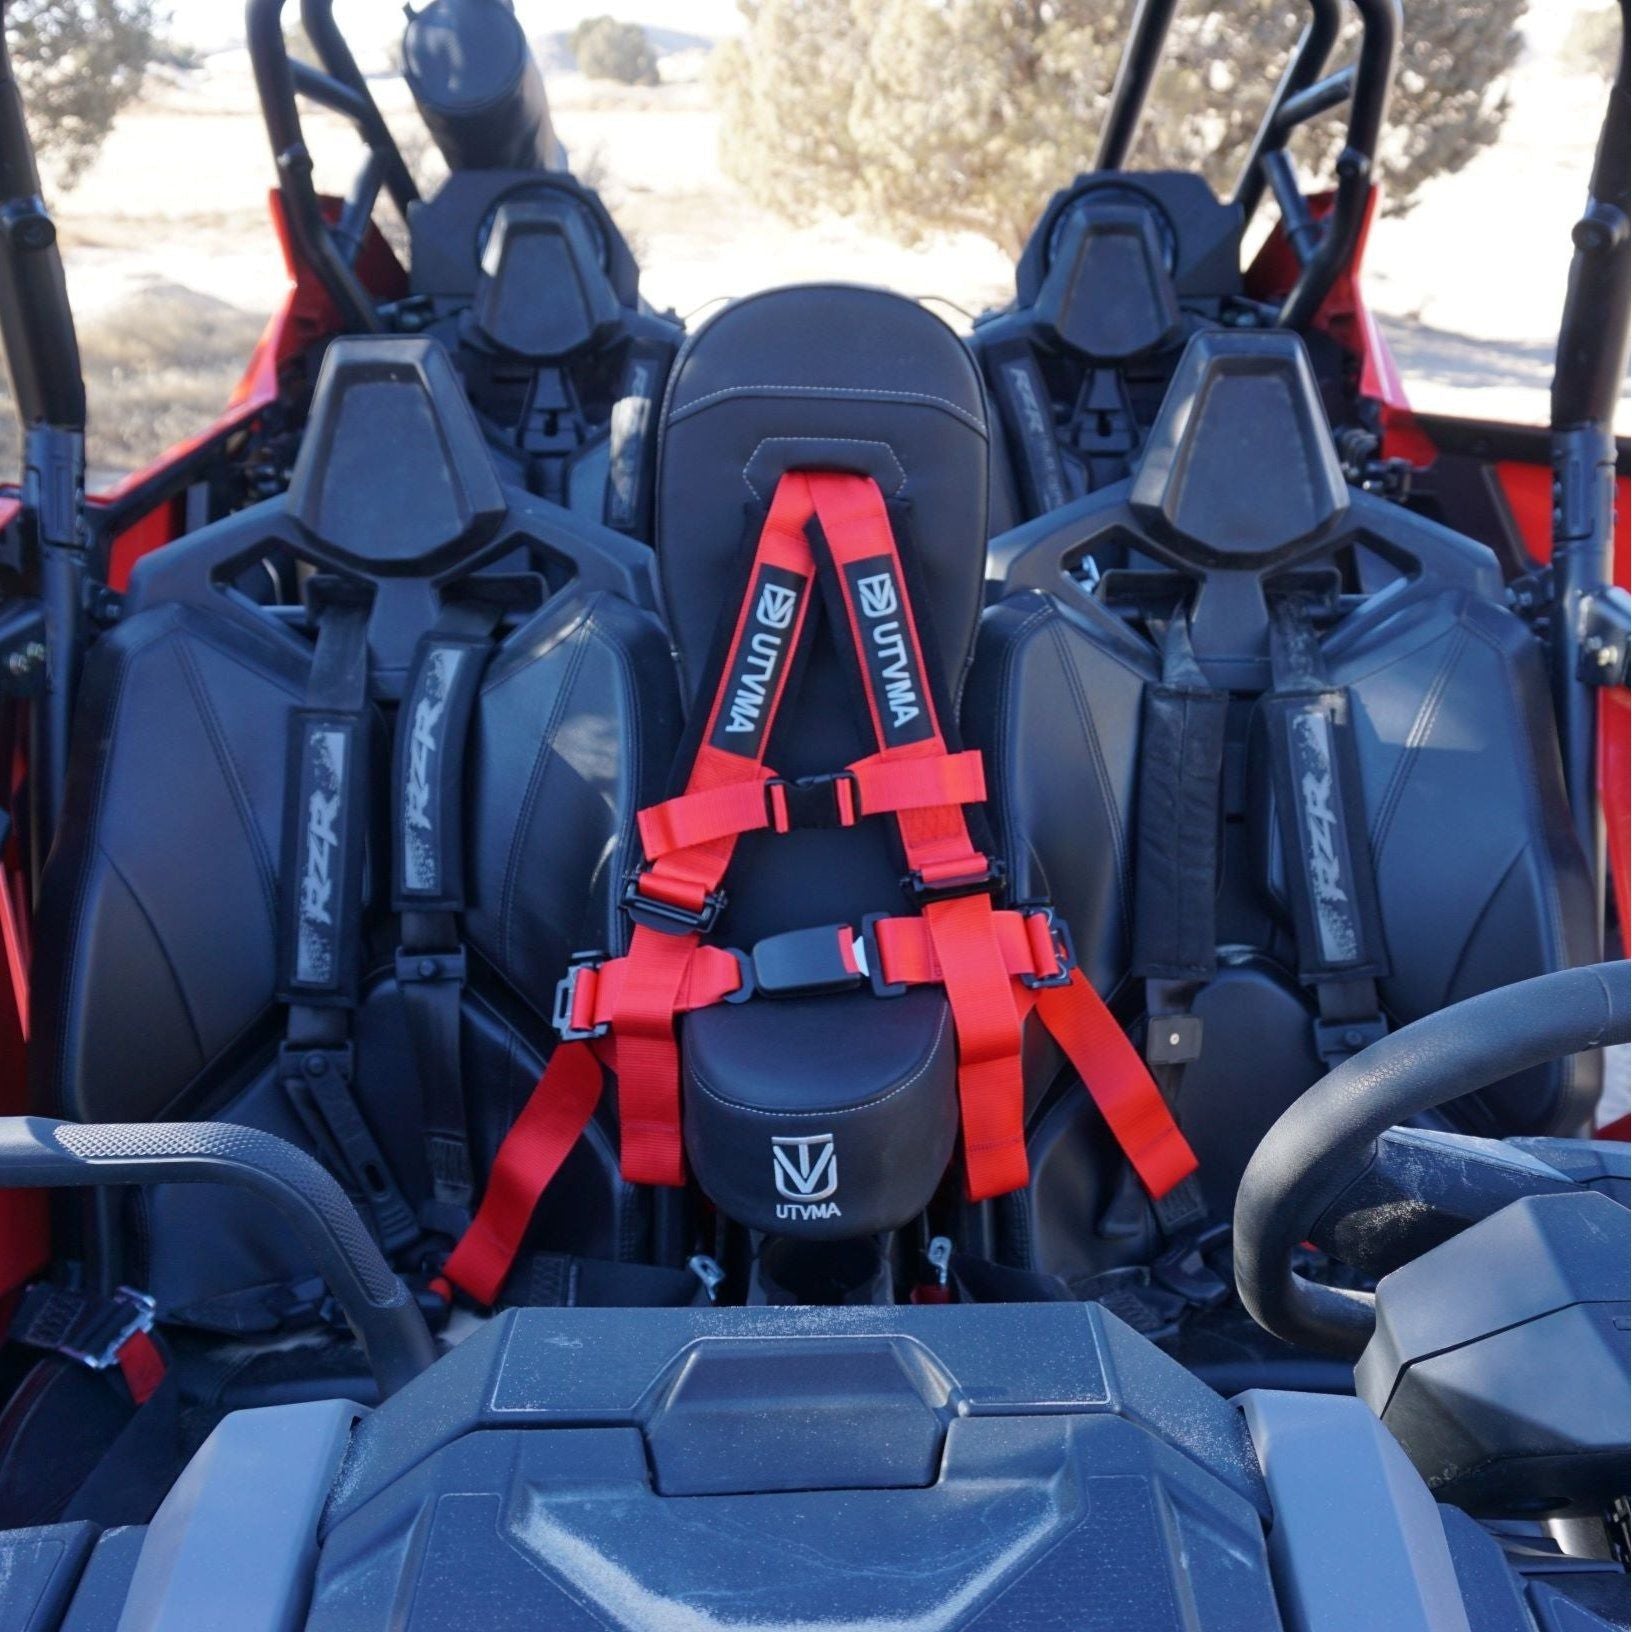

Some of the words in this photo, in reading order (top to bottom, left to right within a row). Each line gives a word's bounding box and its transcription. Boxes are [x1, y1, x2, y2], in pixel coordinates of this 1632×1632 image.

[725, 633, 782, 732] UTVMA
[872, 621, 920, 728] UTVMA
[403, 698, 444, 830] RZR
[301, 790, 341, 926] RZR
[1302, 770, 1348, 902] RZR
[776, 1202, 842, 1220] UTVMA
